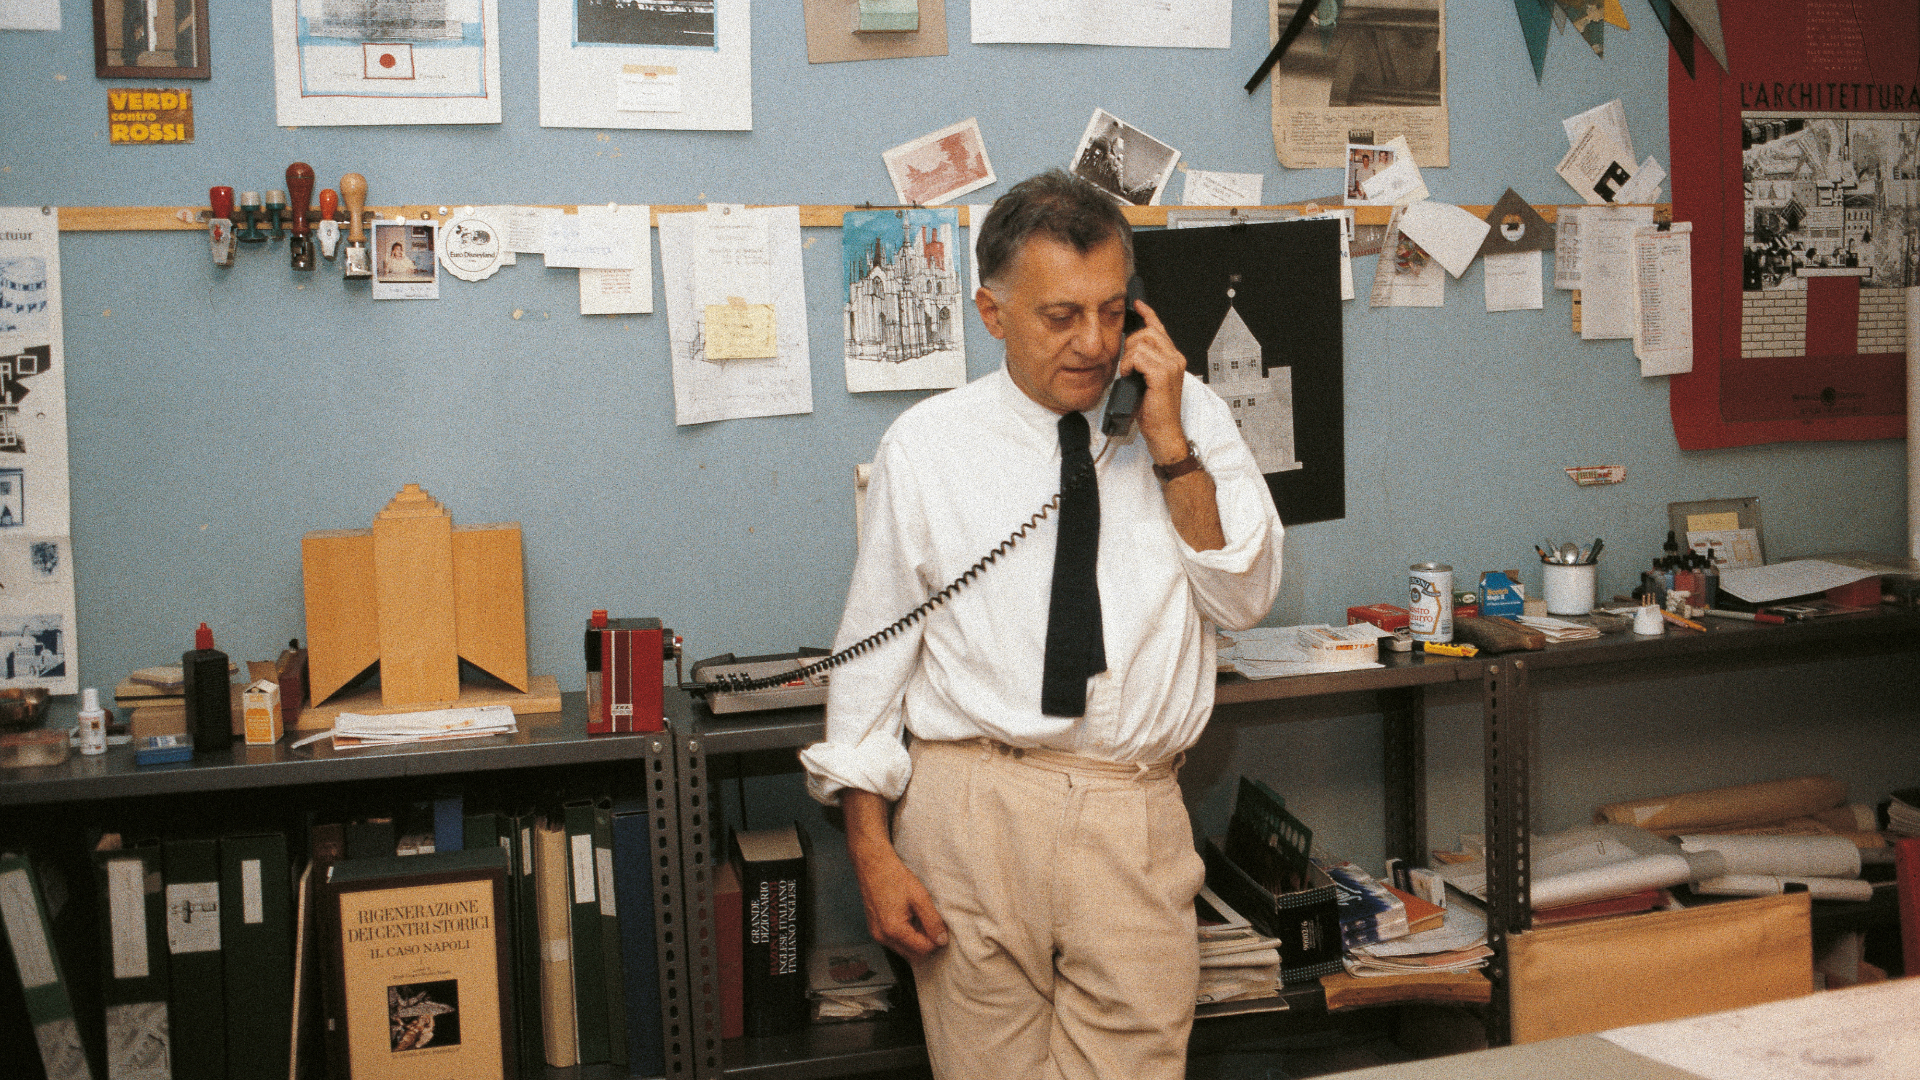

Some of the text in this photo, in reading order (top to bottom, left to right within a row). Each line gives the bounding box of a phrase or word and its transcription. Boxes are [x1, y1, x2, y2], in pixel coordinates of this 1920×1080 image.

[111, 92, 188, 110] VERDI
[1740, 82, 1920, 110] L'ARCHITETTURA
[111, 112, 157, 121] contro
[112, 123, 185, 141] ROSSI
[358, 899, 479, 925] RIGENERAZIONE
[751, 899, 760, 944] GRANDE
[760, 881, 769, 943] DIZIONARIO
[349, 915, 489, 943] DEI CENTRI STORICI
[779, 880, 788, 974] INGLESE ITALIANO
[788, 879, 797, 974] ITALIANO INGLESE
[370, 939, 471, 960] IL CASO NAPOLI
